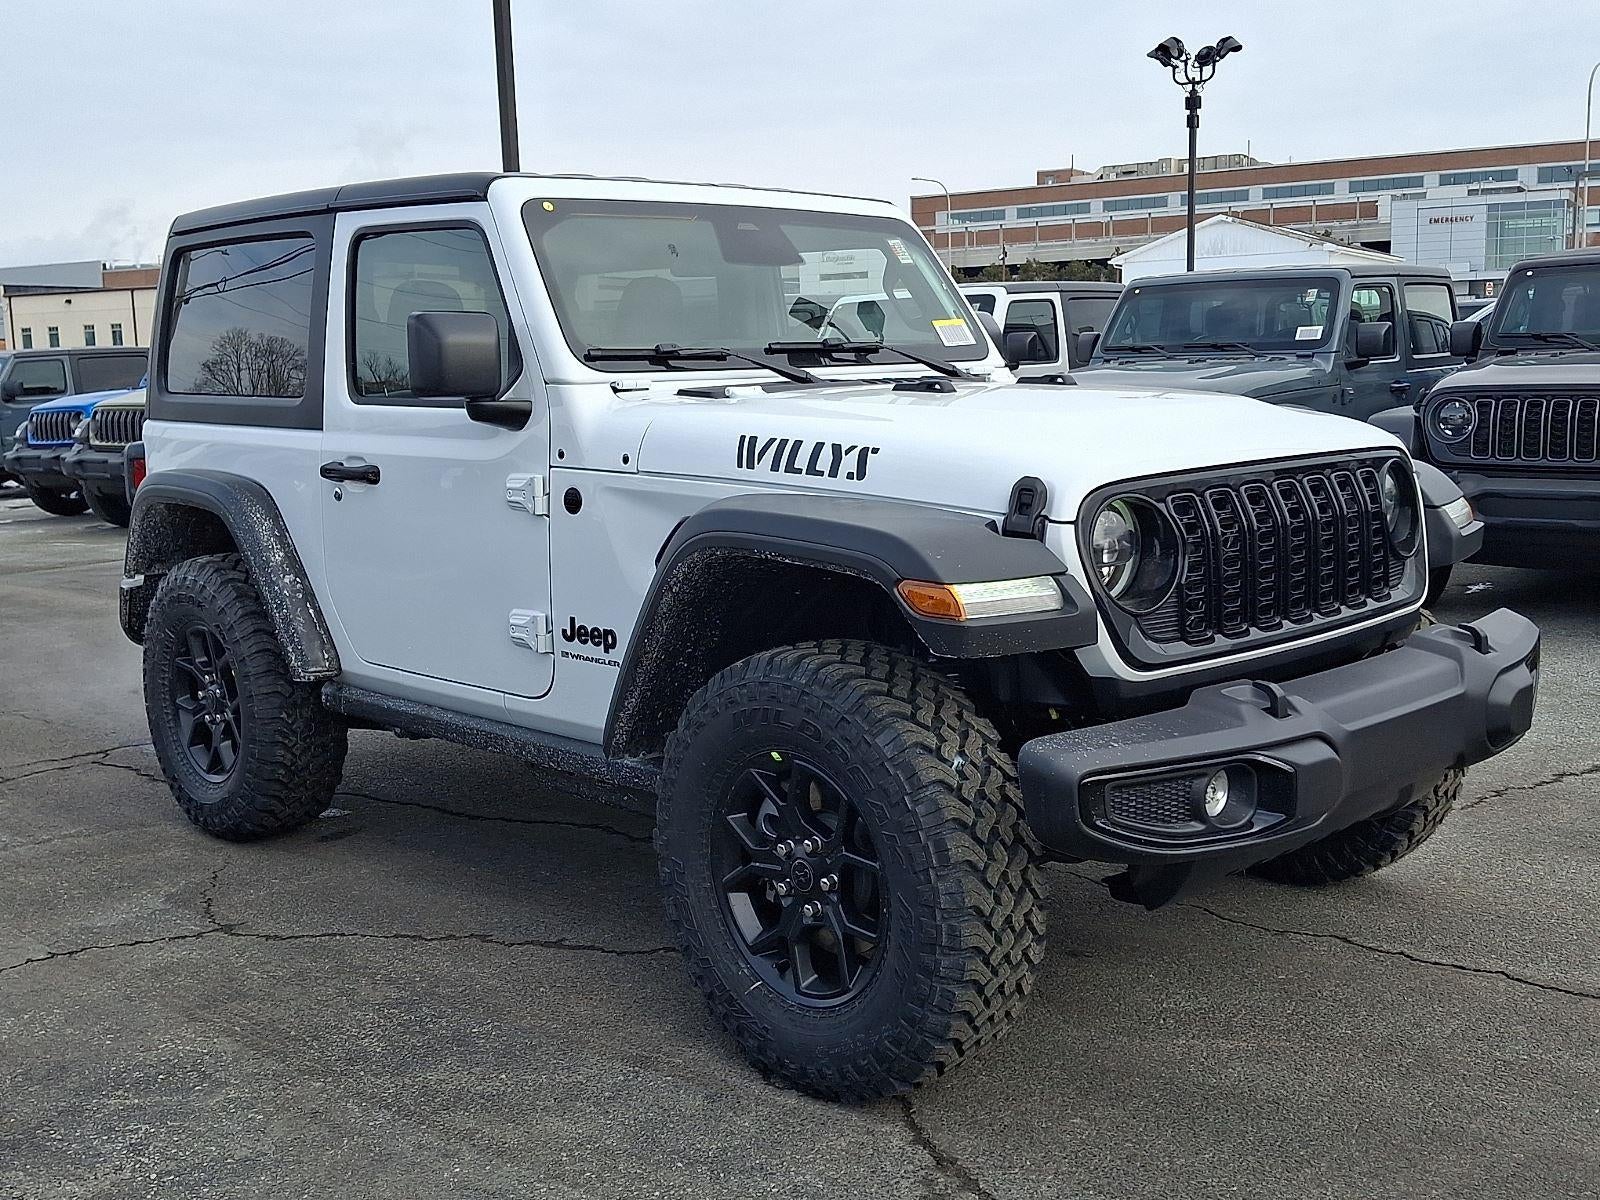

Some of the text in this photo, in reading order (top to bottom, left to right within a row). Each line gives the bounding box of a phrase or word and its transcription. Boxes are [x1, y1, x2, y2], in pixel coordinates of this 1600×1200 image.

[1429, 215, 1475, 225] EMERGENCY
[737, 435, 880, 481] WILLYS
[562, 616, 618, 654] Jeep
[570, 652, 620, 668] WRANGLER
